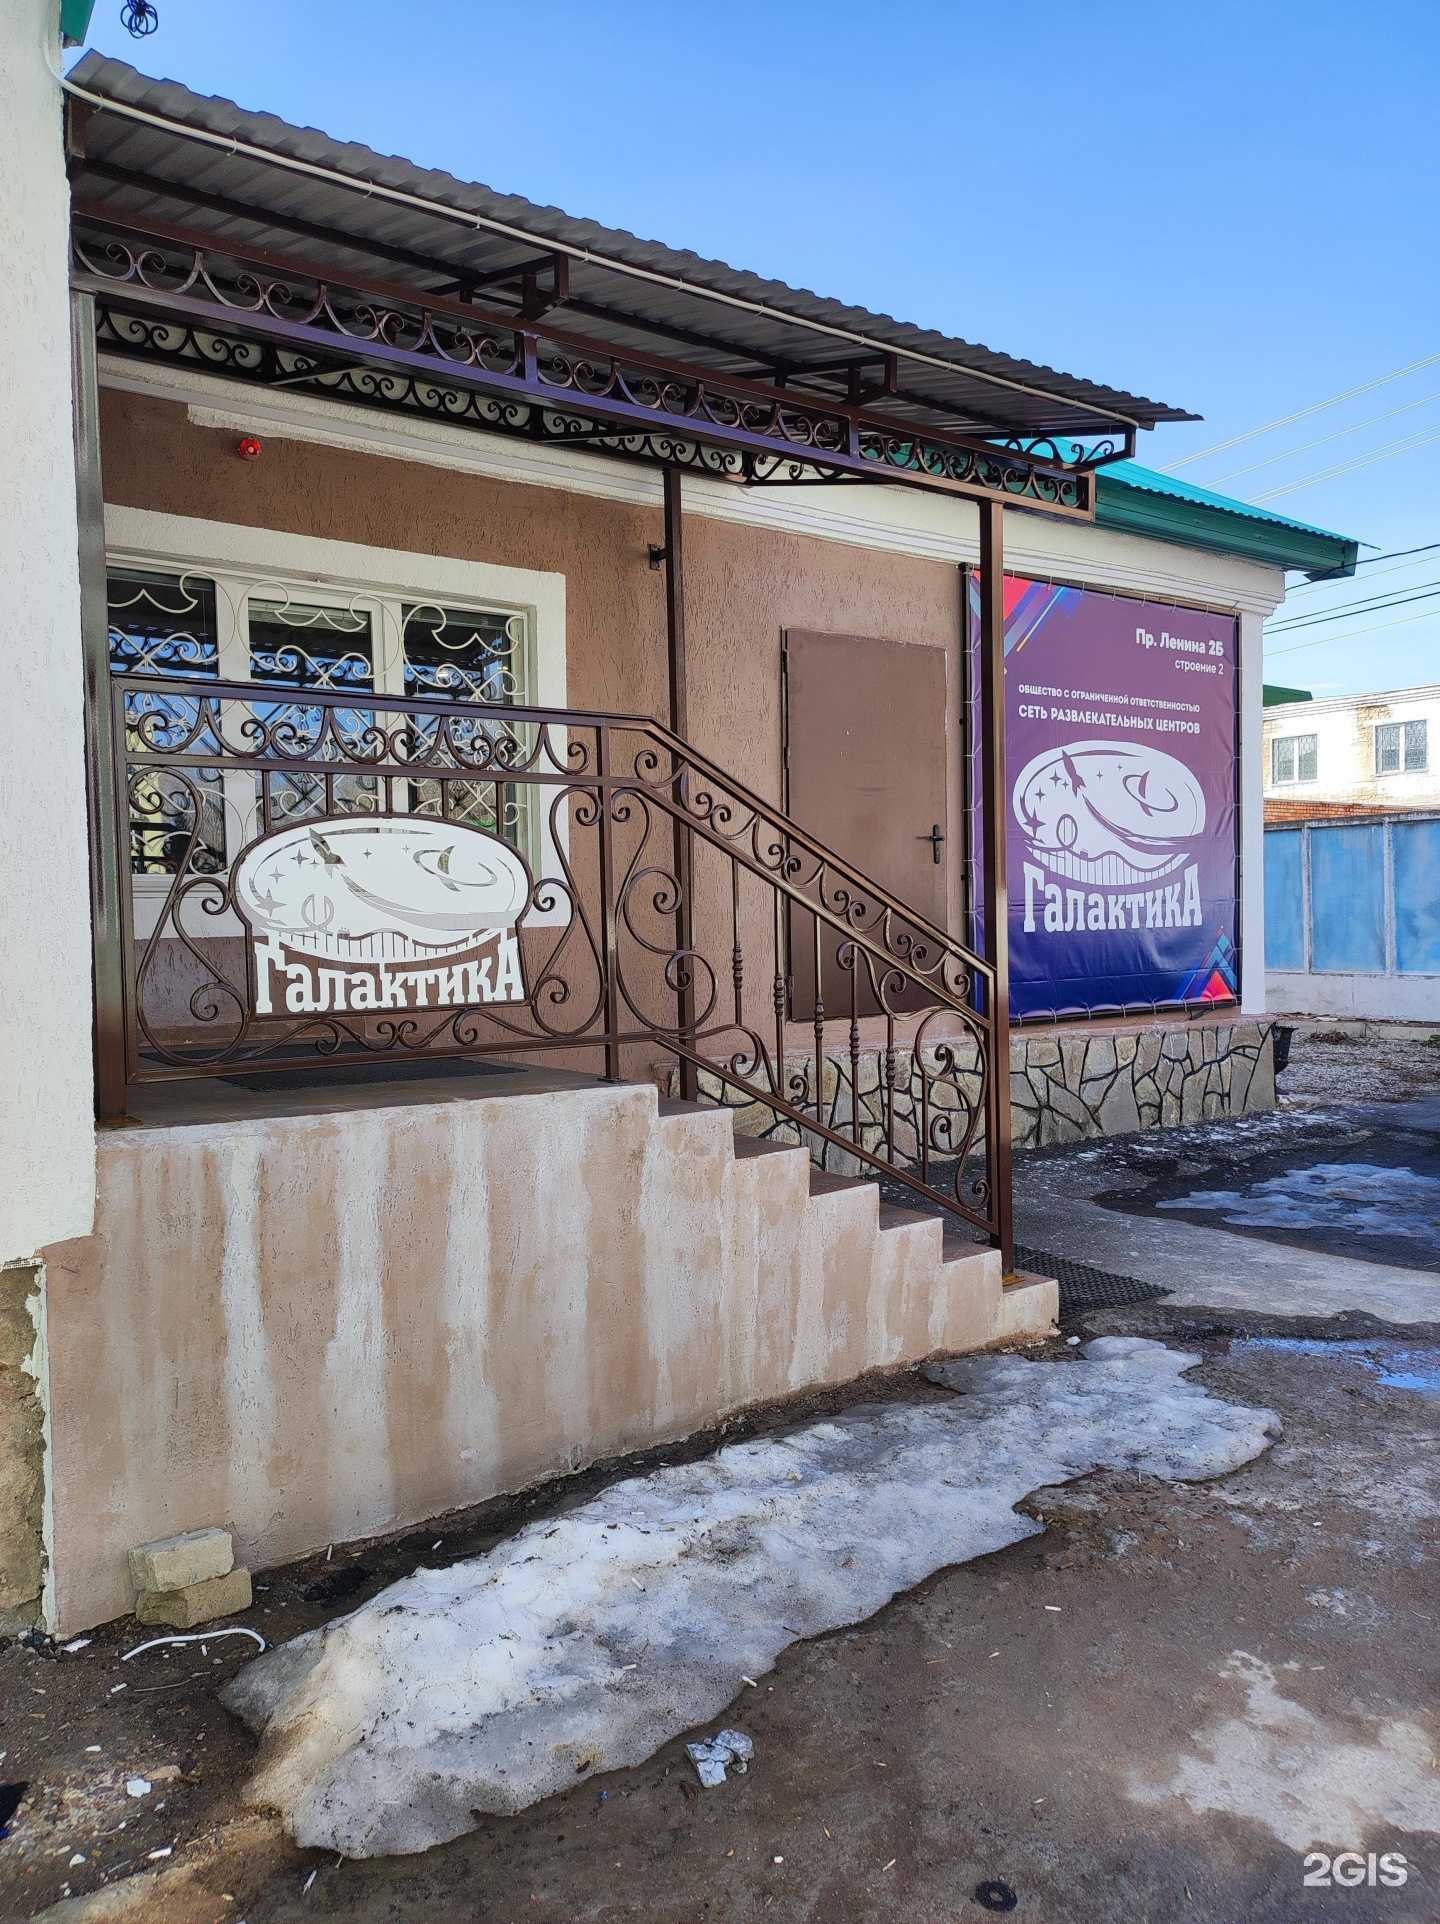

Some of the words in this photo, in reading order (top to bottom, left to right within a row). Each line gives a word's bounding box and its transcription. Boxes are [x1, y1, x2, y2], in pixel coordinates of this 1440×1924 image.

[1136, 628, 1157, 649] Пр.
[1160, 632, 1206, 654] Ленина
[1209, 640, 1224, 657] 2Б
[1175, 660, 1217, 673] строение
[1218, 663, 1224, 675] 2
[1018, 684, 1062, 698] ОБЩЕСТВО
[1063, 689, 1070, 698] С
[1071, 690, 1129, 705] ОГРАНИЧЕННОЙ
[1130, 697, 1200, 713] ОТВЕТСТВЕННОСТЬЮ
[1018, 704, 1048, 720] СЕТЬ
[1050, 707, 1154, 730] РАЗВЛЕКАТЕЛЬНЫХ
[1155, 718, 1201, 734] ЦЕНТРОВ
